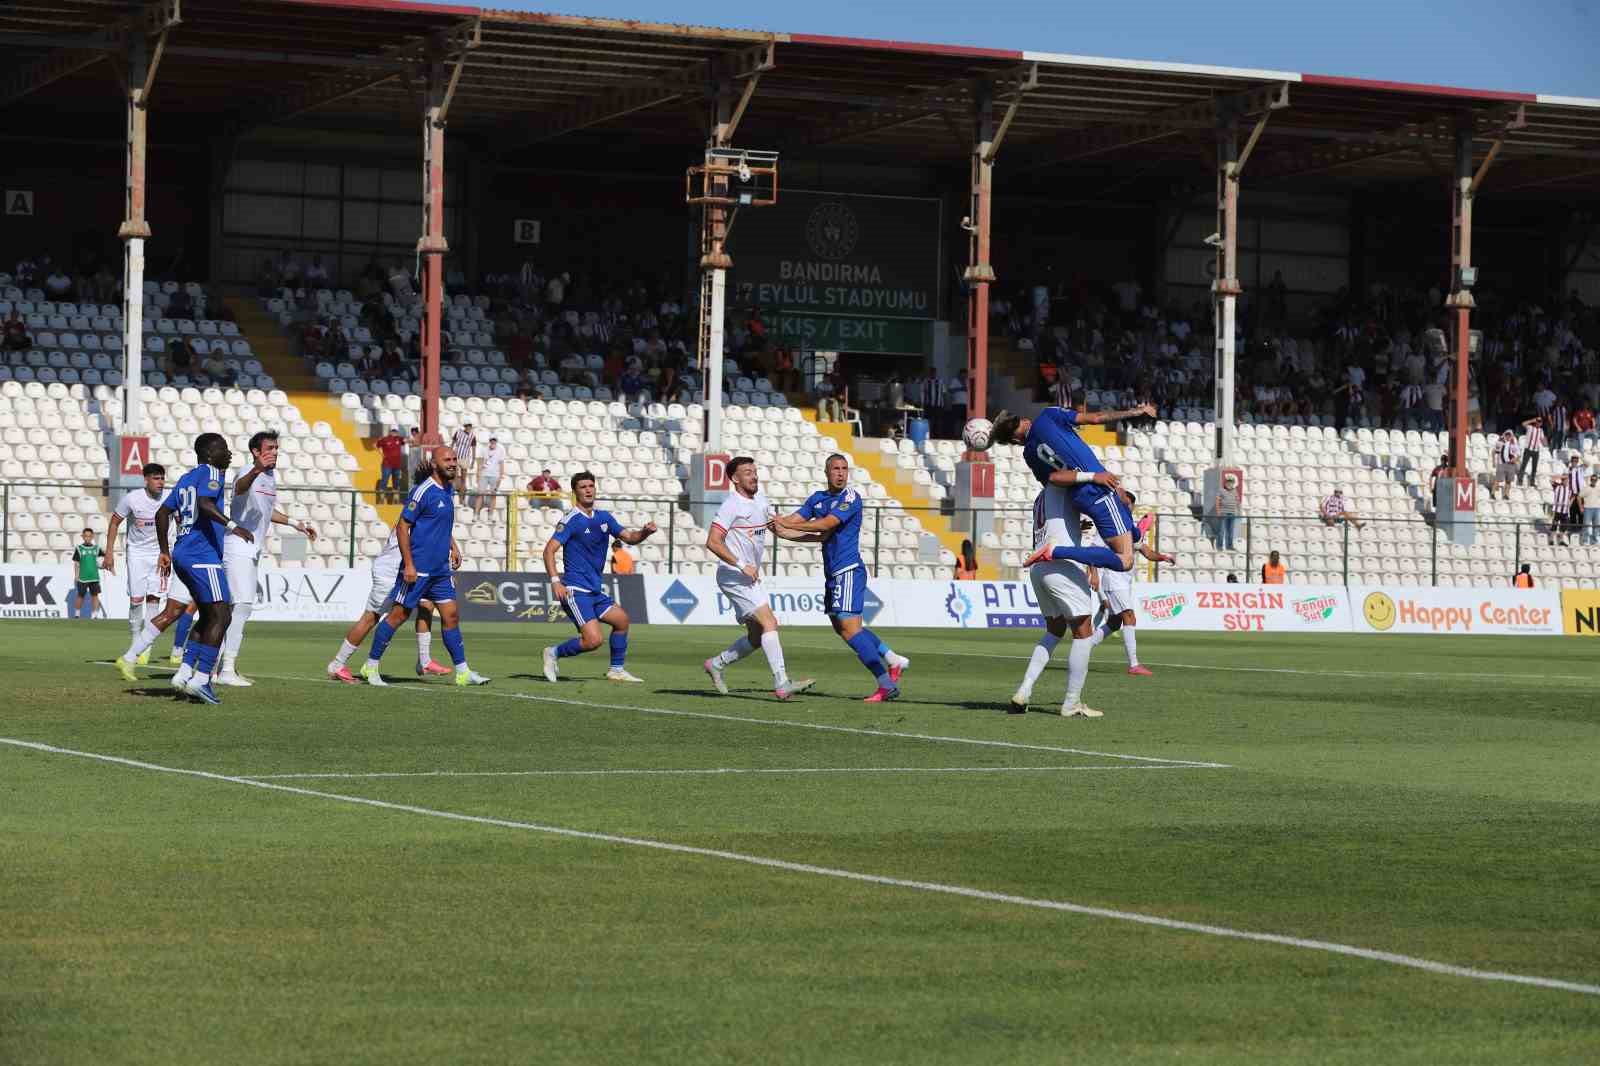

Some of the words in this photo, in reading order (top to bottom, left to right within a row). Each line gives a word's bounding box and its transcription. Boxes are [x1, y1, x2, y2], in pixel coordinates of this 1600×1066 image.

[8, 192, 30, 213] A
[779, 260, 882, 284] BANDIRMA
[758, 279, 819, 305] EYLÜL
[824, 287, 927, 310] STADYUMU
[839, 319, 889, 338] EXIT
[125, 441, 145, 471] A
[708, 459, 728, 487] D
[1456, 481, 1473, 508] M
[1196, 588, 1284, 609] ZENGİN
[1223, 610, 1265, 631] SÜT
[1398, 599, 1473, 631] Happy
[1479, 601, 1552, 625] Center
